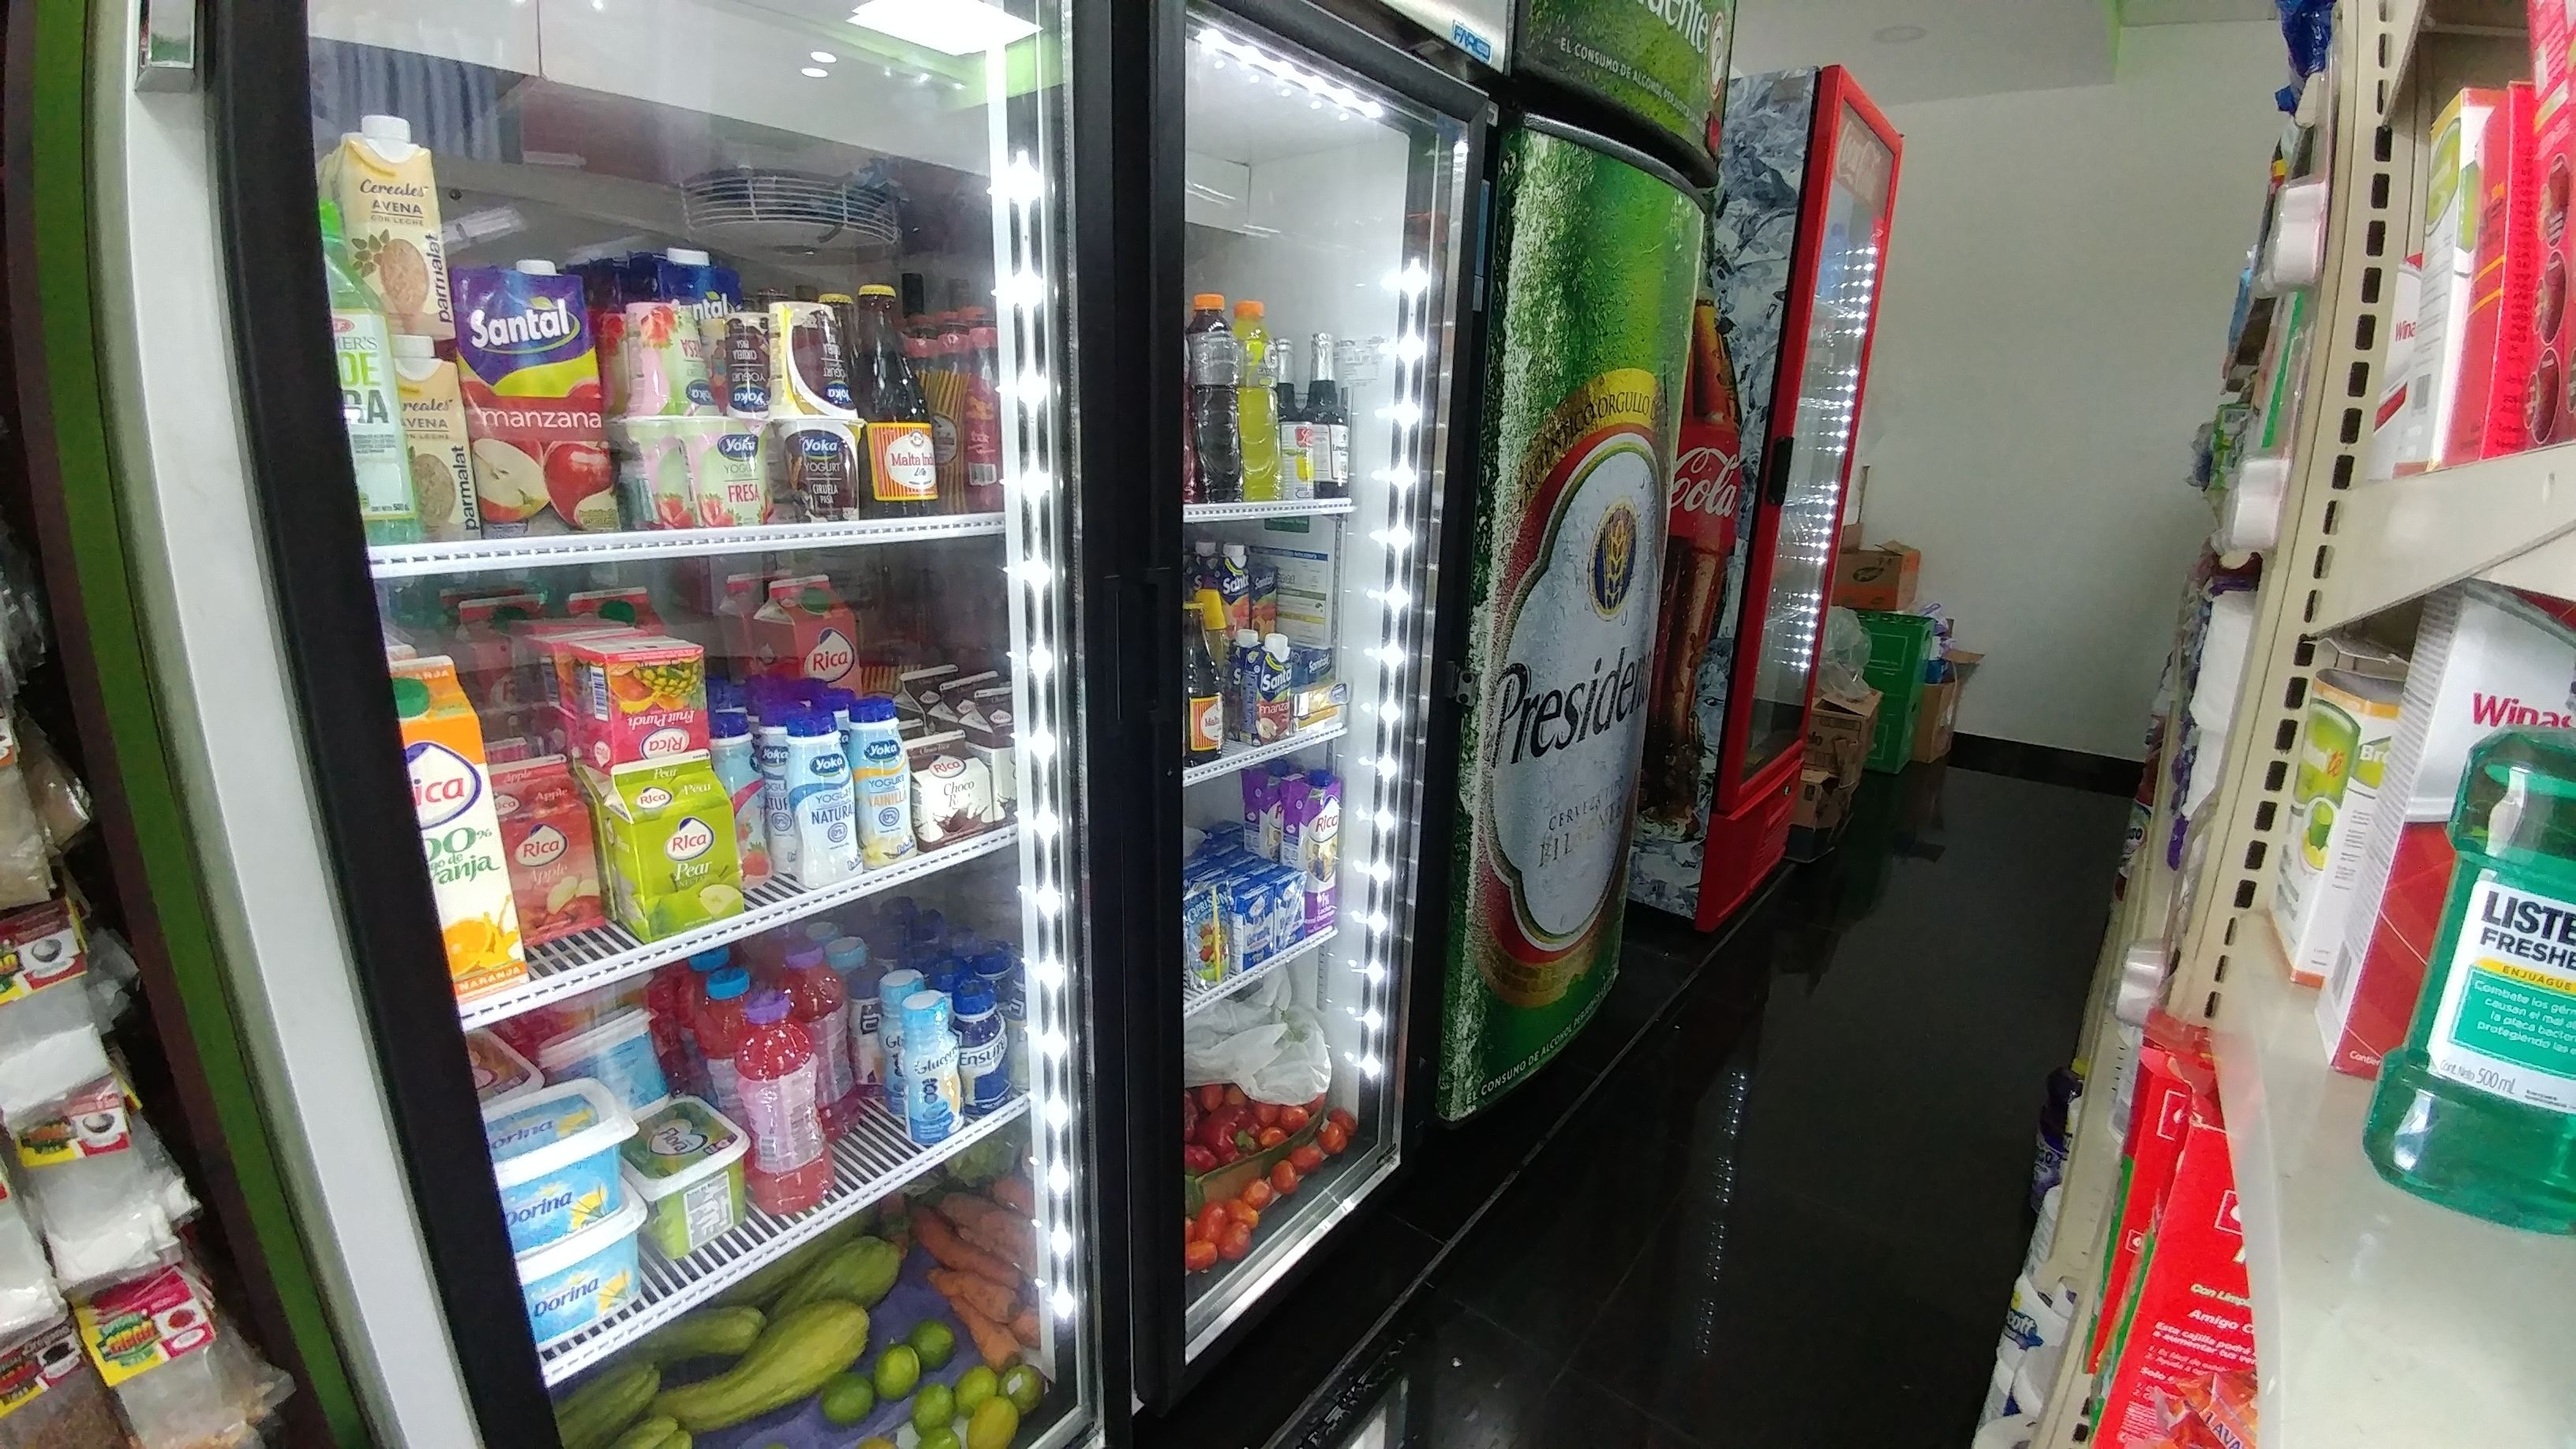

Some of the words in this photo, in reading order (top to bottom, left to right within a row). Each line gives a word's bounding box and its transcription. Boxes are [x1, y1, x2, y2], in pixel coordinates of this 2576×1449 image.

[1574, 43, 1619, 73] CONSUMO
[1620, 63, 1631, 79] DE
[360, 178, 426, 197] Cereales
[372, 199, 423, 215] AVENA
[428, 232, 453, 324] parmalat
[470, 298, 575, 349] Santal
[734, 389, 766, 406] Yoka
[1598, 391, 1650, 419] ORGULLO
[481, 410, 602, 429] manzana
[724, 436, 756, 452] Yoka
[803, 437, 838, 454] Yoka
[803, 461, 840, 473] YOGURT
[891, 452, 921, 466] Malta
[452, 444, 476, 531] parmalat
[728, 484, 761, 503] FRESA
[812, 483, 838, 496] CIRUELA
[812, 650, 848, 671] Rica
[627, 713, 667, 731] Punch
[667, 710, 695, 725] Fruit
[649, 736, 683, 752] Rica
[869, 743, 897, 756] Yoka
[814, 757, 843, 771] Yoka
[934, 760, 961, 773] Rica
[869, 774, 905, 788] YOGURT
[943, 780, 975, 796] Choco
[535, 788, 568, 803] Apple
[640, 793, 667, 805] Rica
[523, 840, 560, 858] Rica
[672, 833, 707, 852] Rica
[447, 852, 463, 865] de
[674, 860, 713, 882] Pear
[459, 964, 522, 993] NARANJA
[2502, 965, 2572, 990] ENJUAGUE
[2474, 979, 2530, 1005] Combate
[2531, 997, 2548, 1009] los
[2484, 998, 2527, 1017] causan
[2490, 1010, 2502, 1022] la
[2503, 1017, 2536, 1032] placa
[2477, 1021, 2551, 1049] protegiendo
[1481, 1060, 1526, 1096] CONSUMO
[1528, 1050, 1540, 1066] DE
[2476, 1068, 2499, 1089] 500
[2498, 1077, 2516, 1095] mL
[534, 1277, 600, 1317] Dorina
[2190, 1283, 2217, 1298] Con
[2187, 1309, 2240, 1331] Amigo
[2155, 1321, 2181, 1336] Esta
[2181, 1329, 2216, 1345] cajilla
[2162, 1334, 2218, 1354] aumentar
